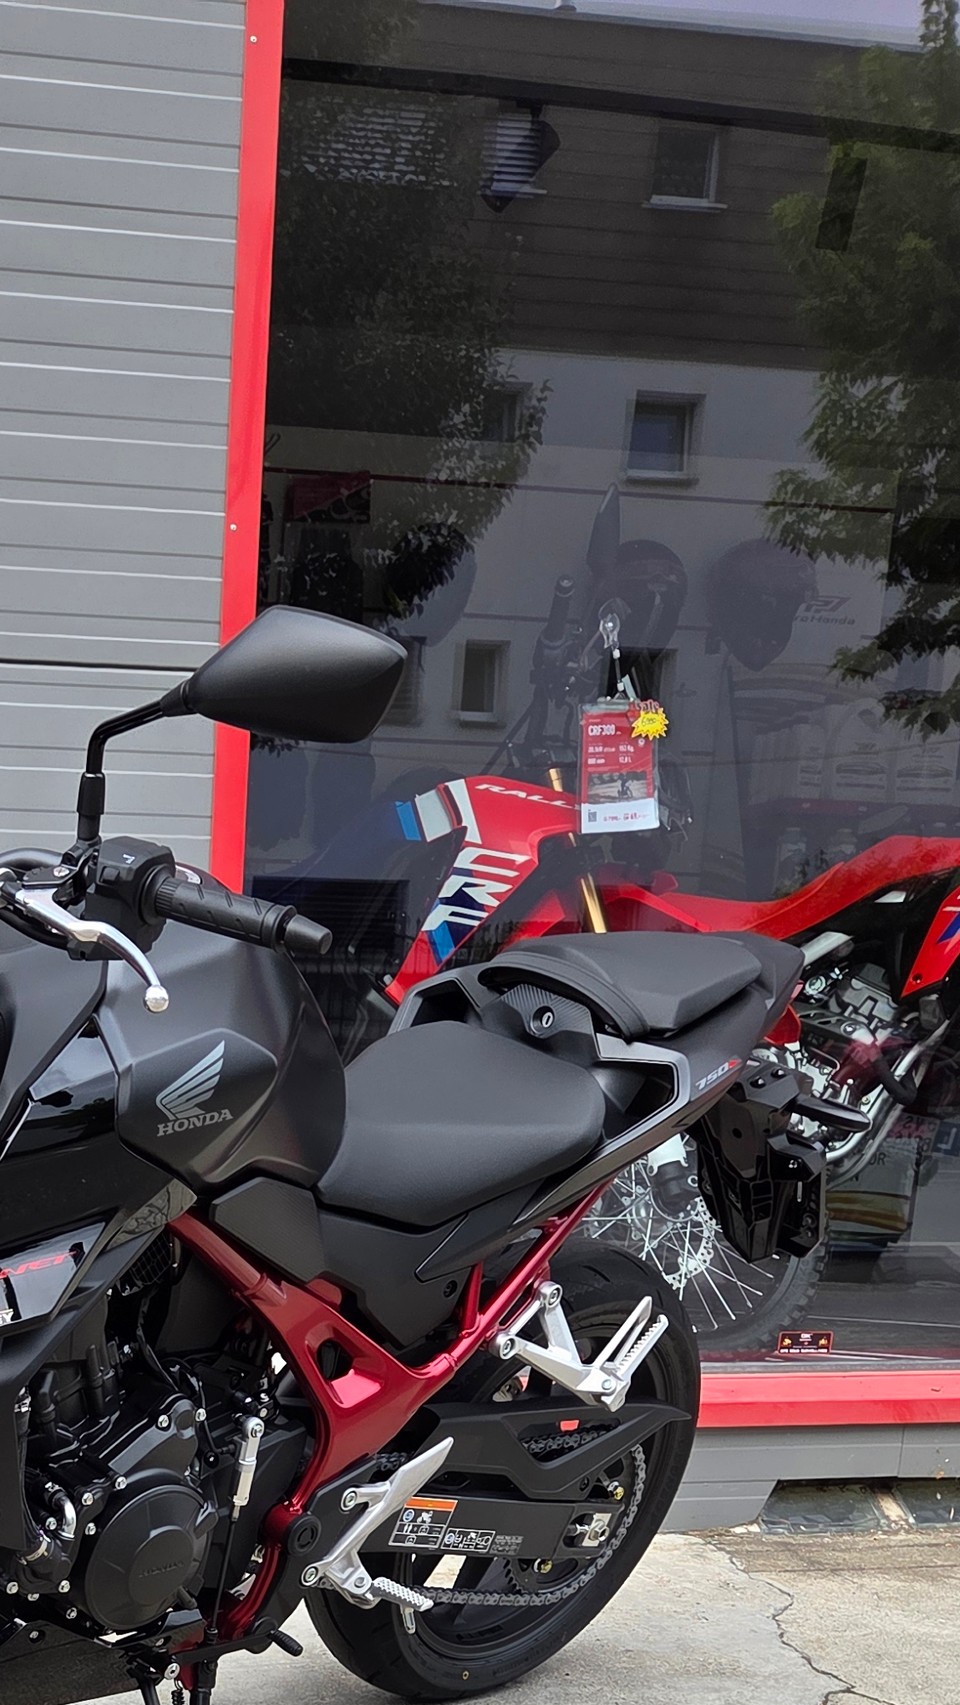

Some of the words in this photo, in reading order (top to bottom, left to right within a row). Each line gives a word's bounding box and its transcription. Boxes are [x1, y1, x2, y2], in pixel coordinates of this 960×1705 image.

[475, 783, 580, 811] RALL
[421, 846, 533, 932] CRF
[157, 1108, 234, 1137] HONDA
